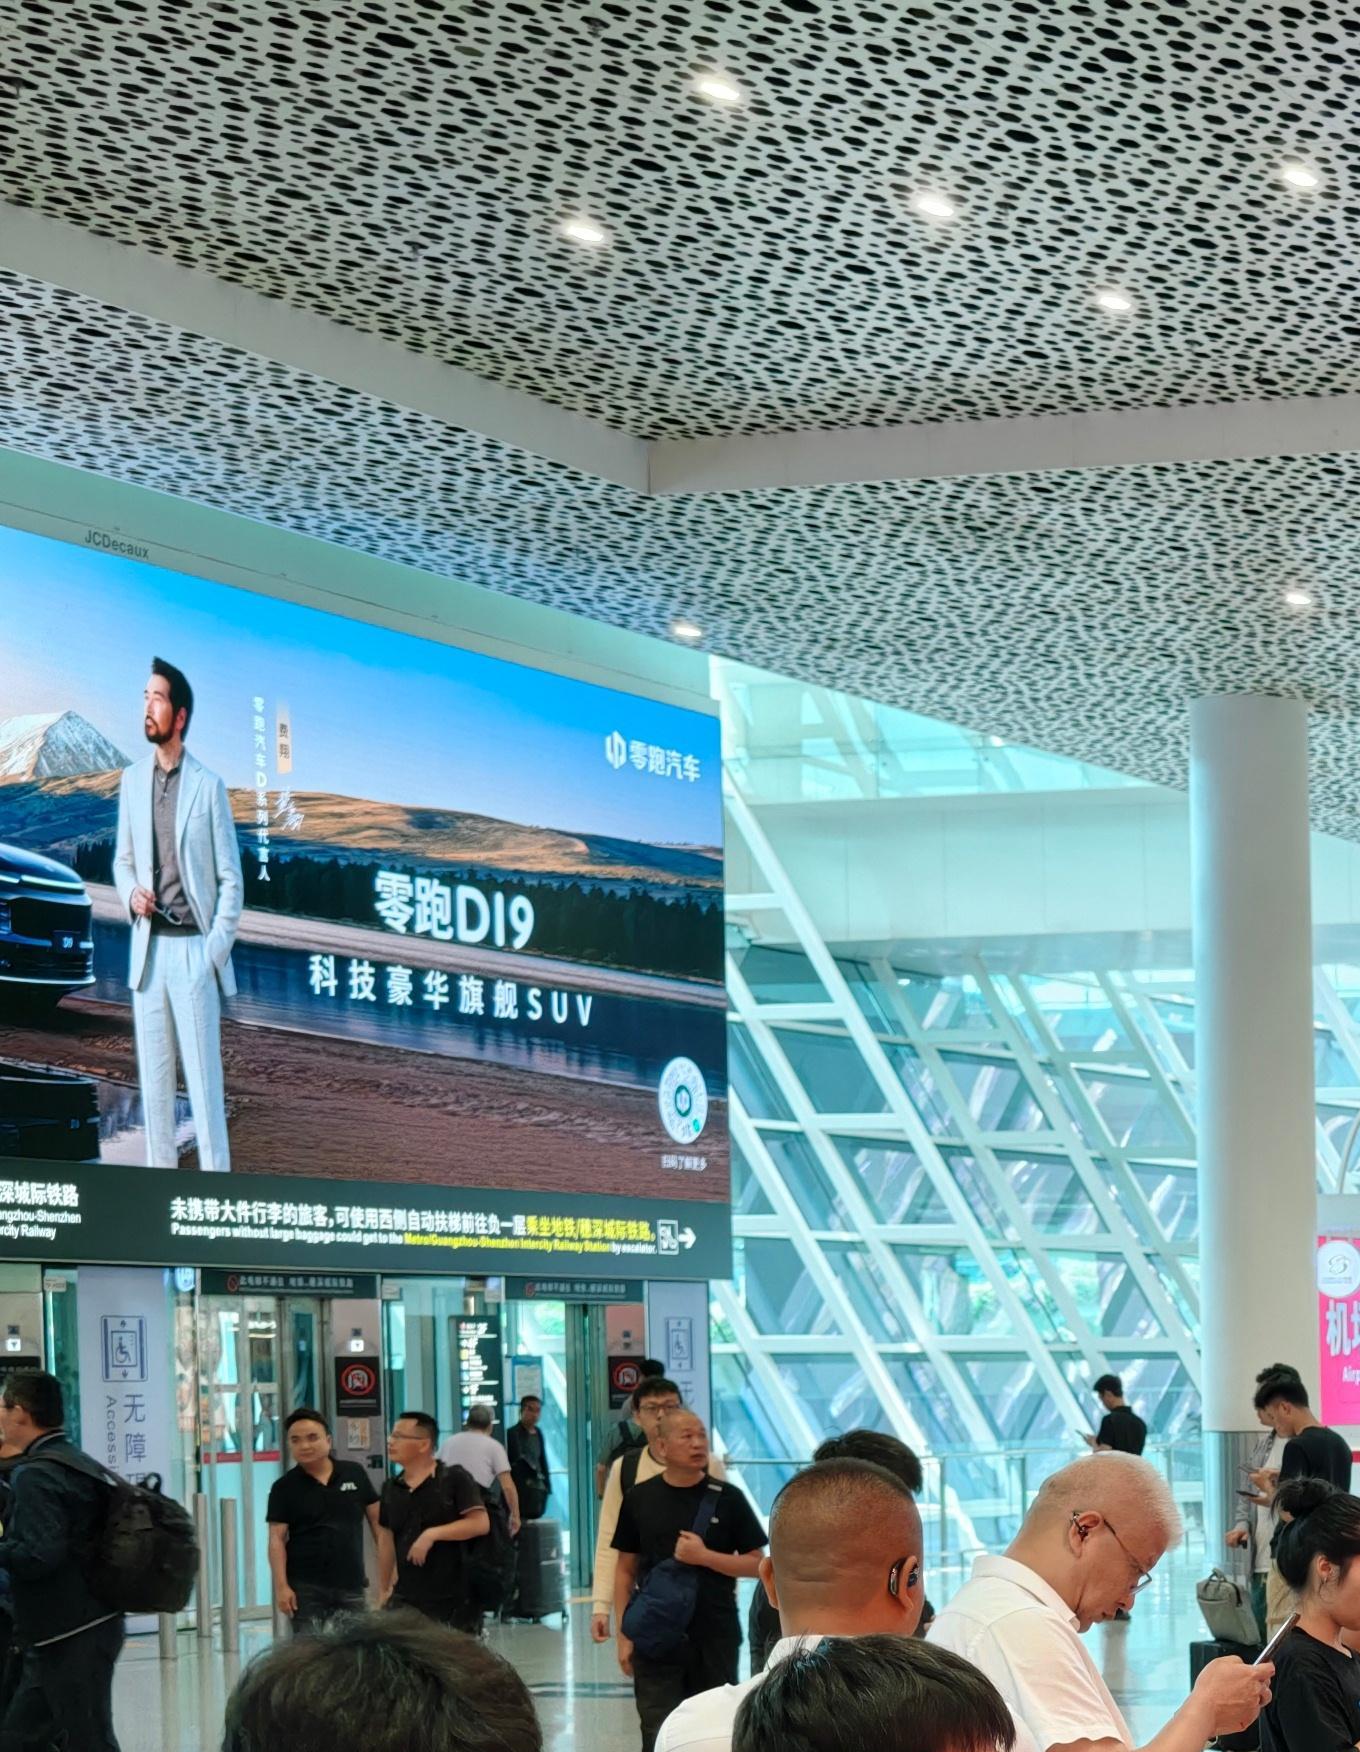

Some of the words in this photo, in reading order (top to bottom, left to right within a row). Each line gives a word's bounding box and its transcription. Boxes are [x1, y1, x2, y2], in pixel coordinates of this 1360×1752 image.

[84, 530, 150, 560] JCDecaux
[629, 739, 701, 783] 零跑汽车
[308, 954, 593, 1027] 科技豪华旗舰SUV
[20, 1224, 57, 1241] Railway
[171, 1222, 231, 1239] Passengers
[232, 1225, 269, 1239] without
[269, 1226, 294, 1242] large
[295, 1227, 335, 1244] baggage
[336, 1230, 362, 1243] could
[363, 1233, 378, 1246] get
[378, 1233, 388, 1244] to
[389, 1232, 403, 1244] the
